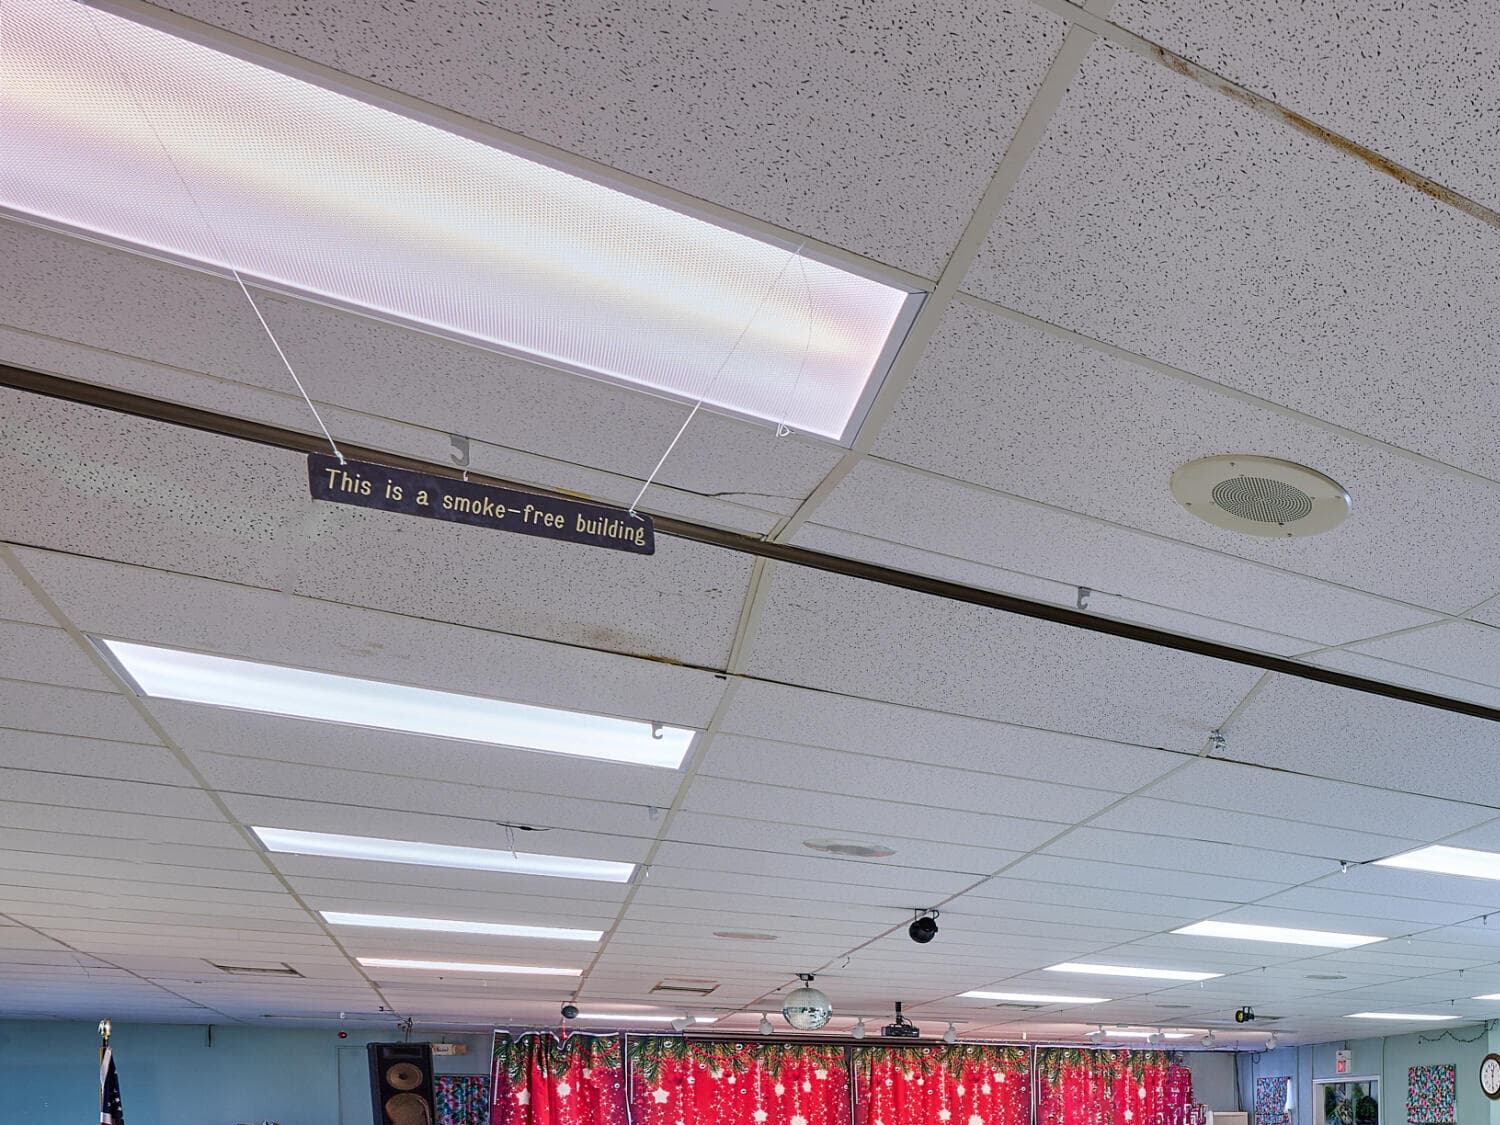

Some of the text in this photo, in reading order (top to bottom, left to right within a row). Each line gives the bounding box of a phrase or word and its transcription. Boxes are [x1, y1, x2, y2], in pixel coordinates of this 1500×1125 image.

[326, 468, 646, 546] This is a smoke-free building
